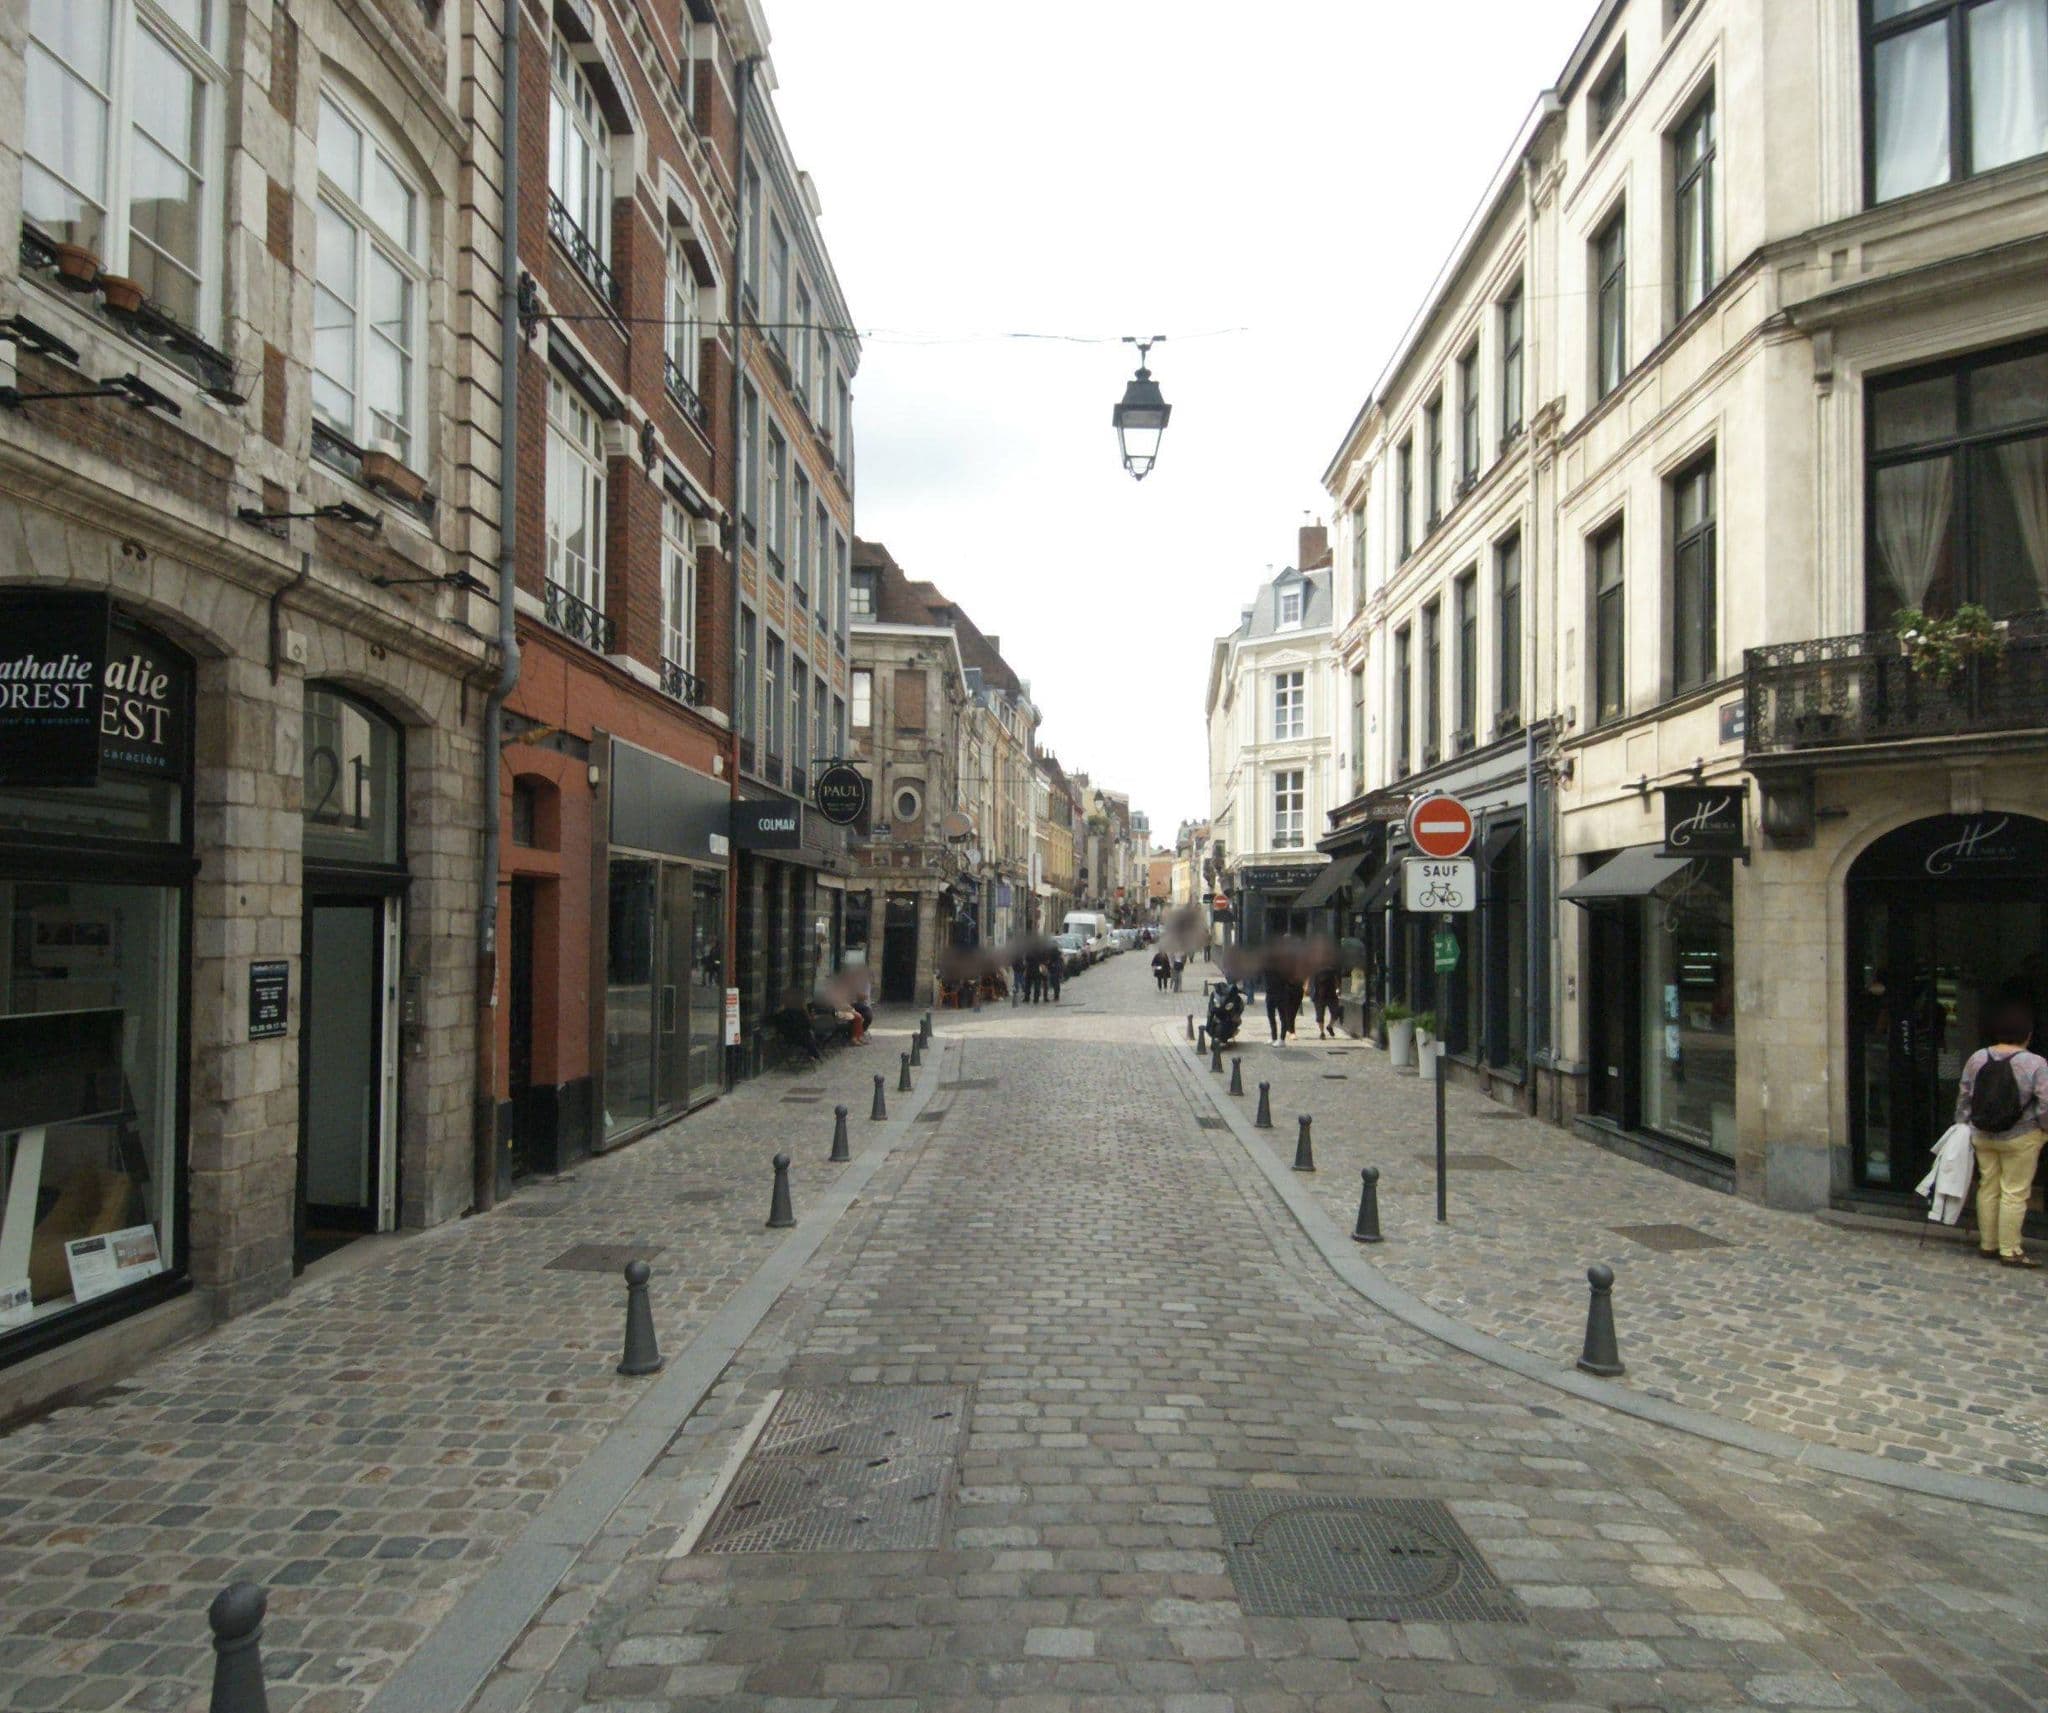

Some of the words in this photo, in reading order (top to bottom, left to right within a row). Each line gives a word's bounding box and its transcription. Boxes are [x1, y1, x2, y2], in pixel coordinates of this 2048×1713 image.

[311, 745, 363, 829] 21
[824, 785, 860, 797] PAUL
[758, 818, 796, 831] COLMAR
[1423, 865, 1459, 877] SAUF
